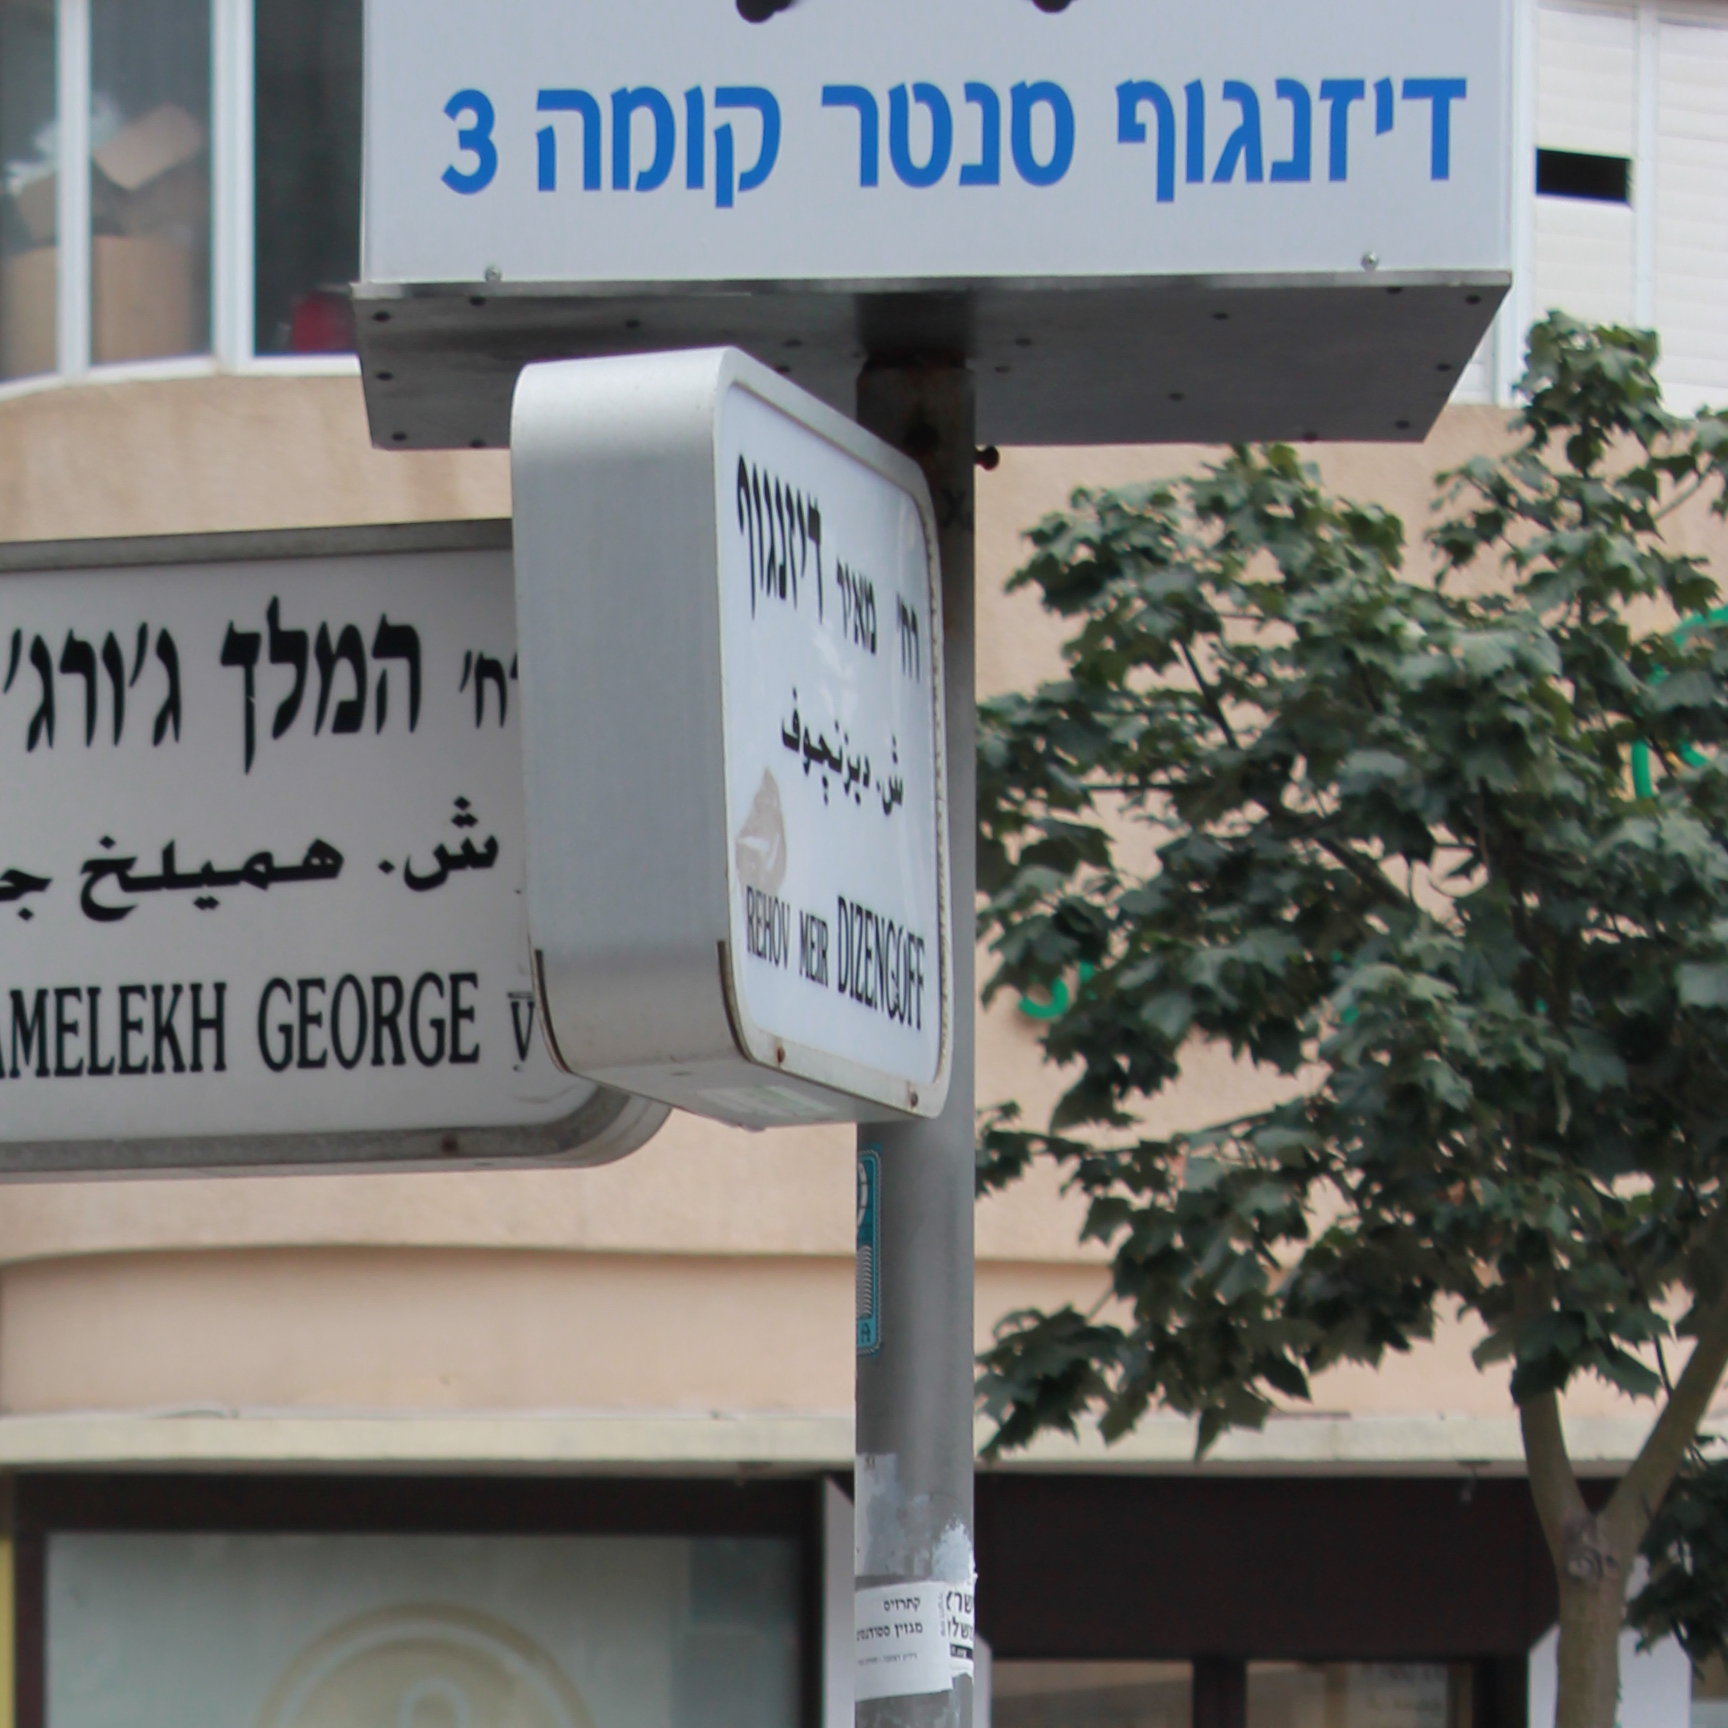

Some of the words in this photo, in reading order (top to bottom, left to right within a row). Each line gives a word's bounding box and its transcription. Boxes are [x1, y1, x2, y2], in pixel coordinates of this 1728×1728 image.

[440, 88, 499, 196] 3
[534, 84, 782, 208] קומה
[821, 80, 1075, 189] סנטר
[1116, 77, 1467, 203] דיזנגוף
[736, 452, 824, 625] דיזנגוף
[836, 556, 877, 656] מאיר
[3, 621, 182, 753] ג'ורג'
[220, 596, 423, 775] המלך
[458, 648, 518, 729] ח'
[746, 884, 790, 970] REHOV
[799, 909, 829, 988] MEIR
[837, 894, 925, 1031] DIZENGOFF
[257, 970, 480, 1072] GEORGE
